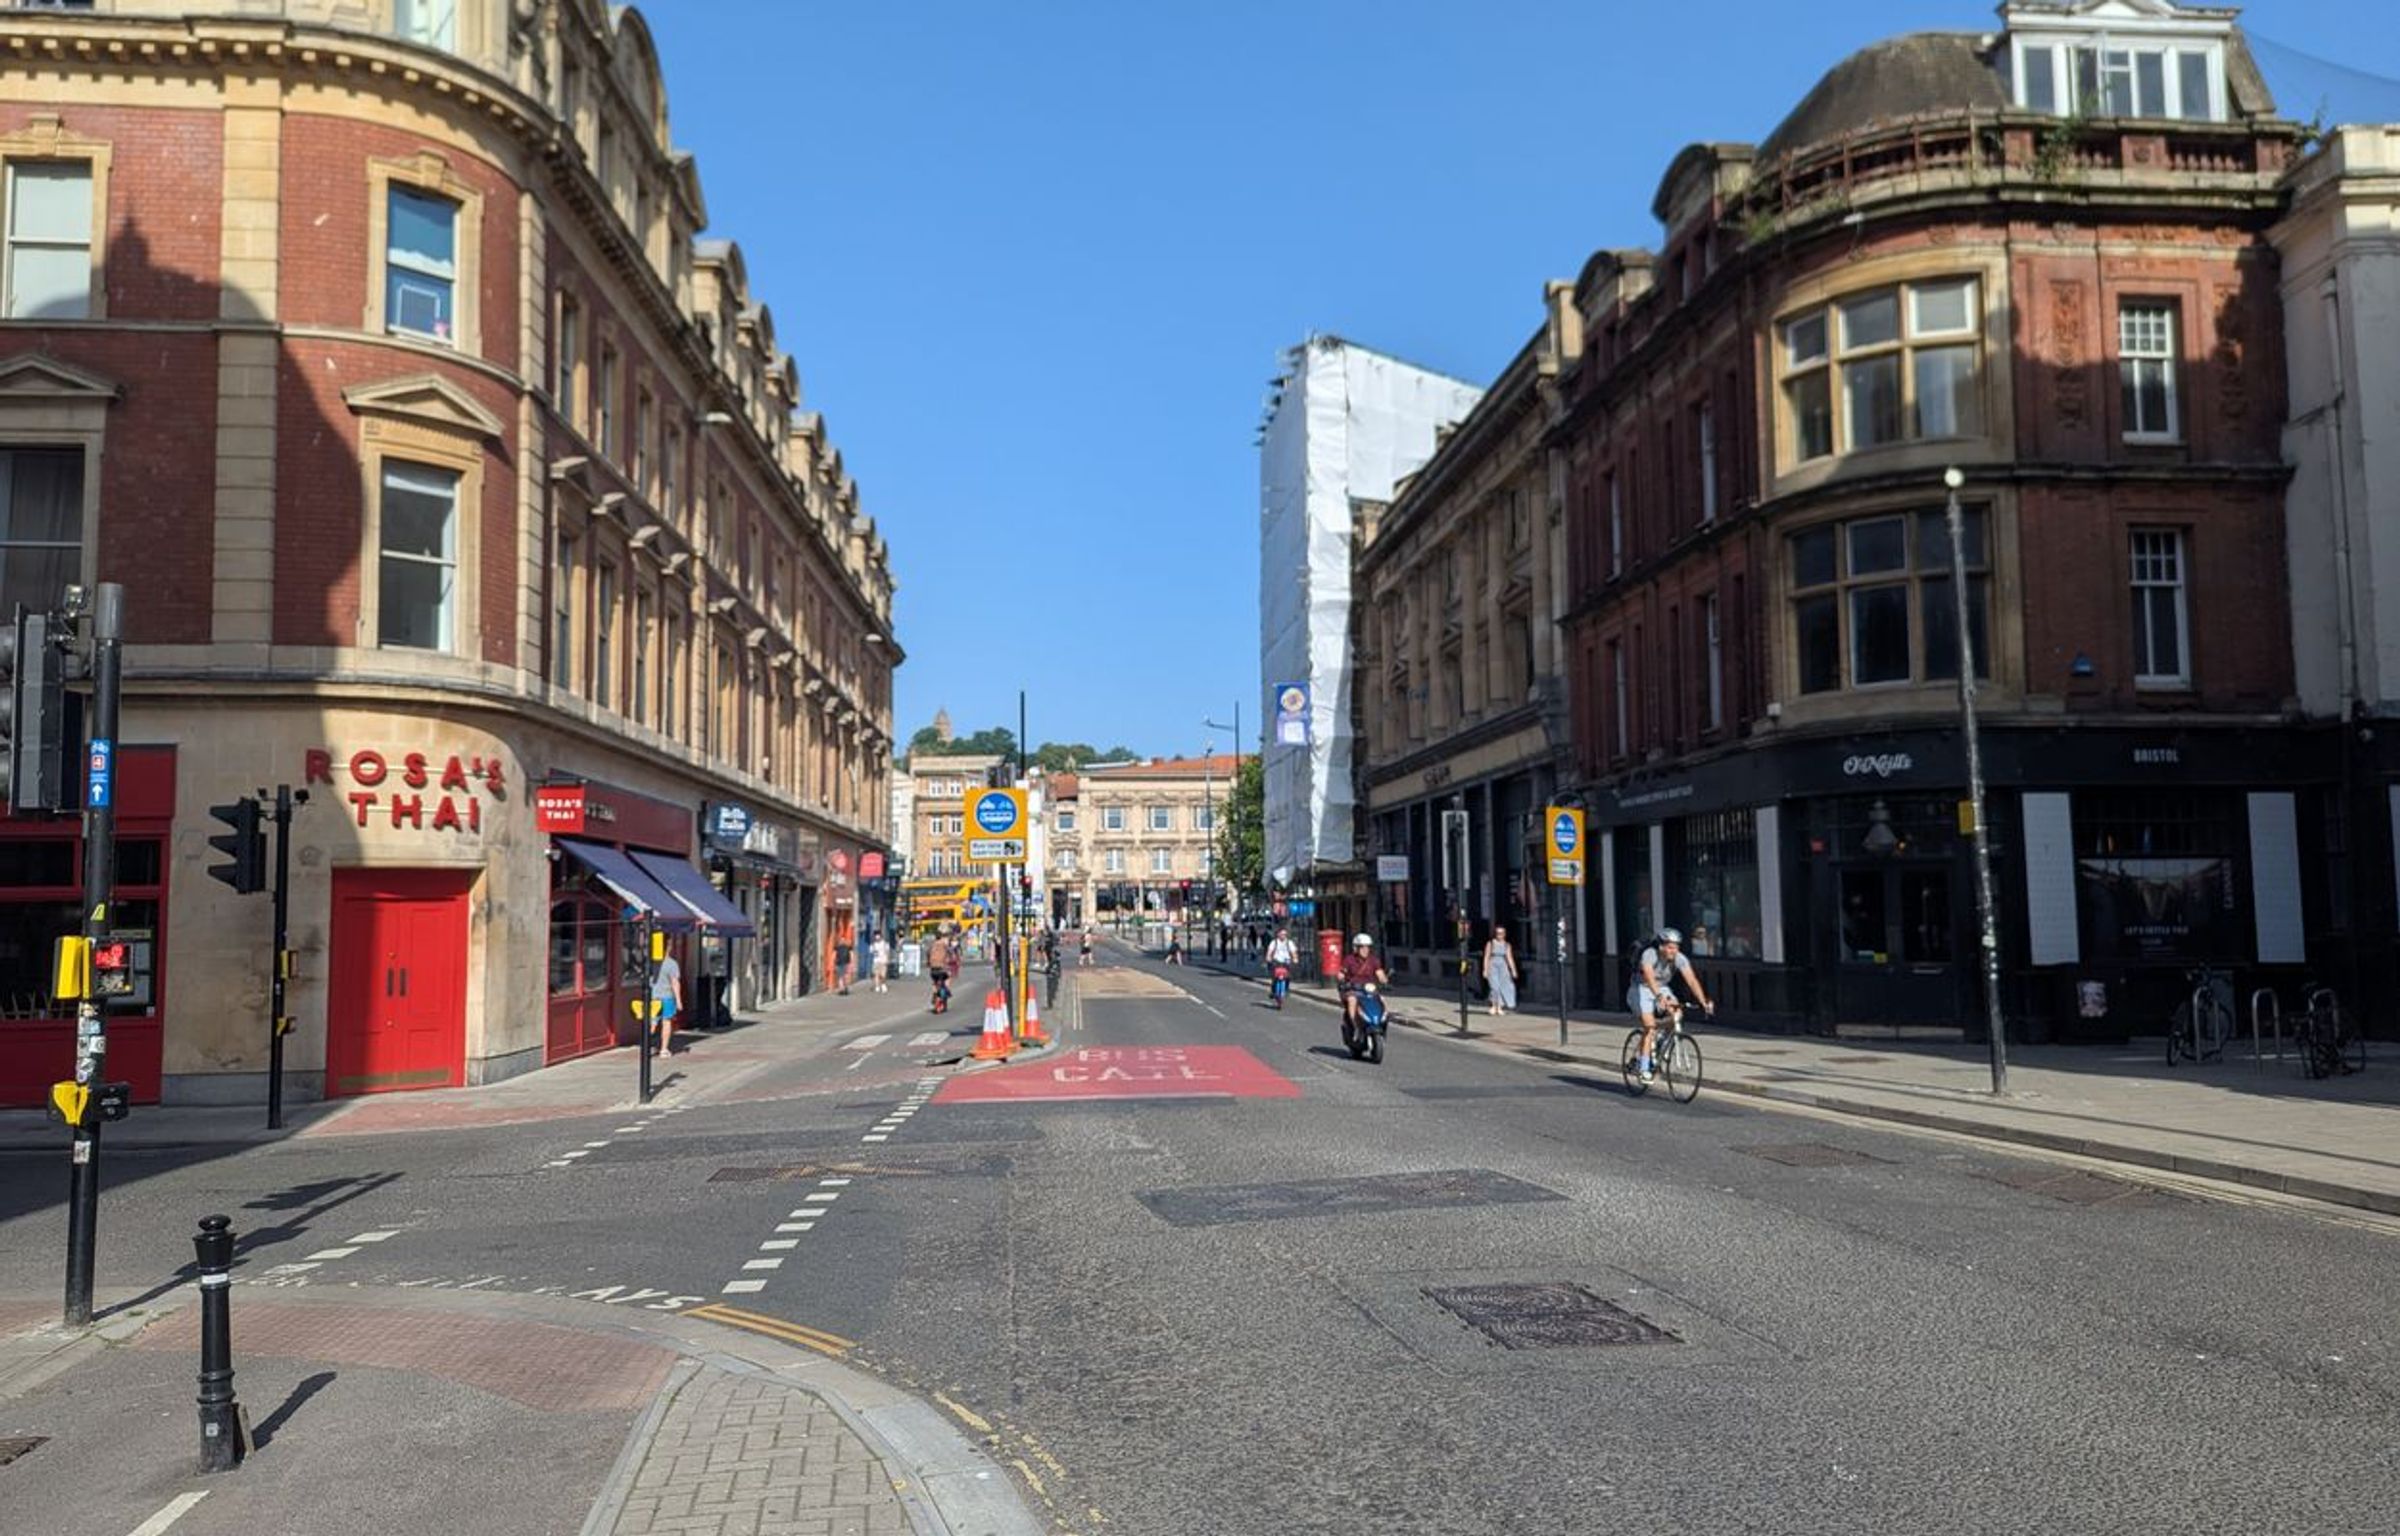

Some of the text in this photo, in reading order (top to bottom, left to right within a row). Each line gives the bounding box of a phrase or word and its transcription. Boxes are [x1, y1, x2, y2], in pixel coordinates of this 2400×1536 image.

[2134, 748, 2179, 763] BRISTOL
[306, 748, 506, 801] ROSA'S
[349, 792, 480, 835] THAI
[546, 810, 575, 820] THAI
